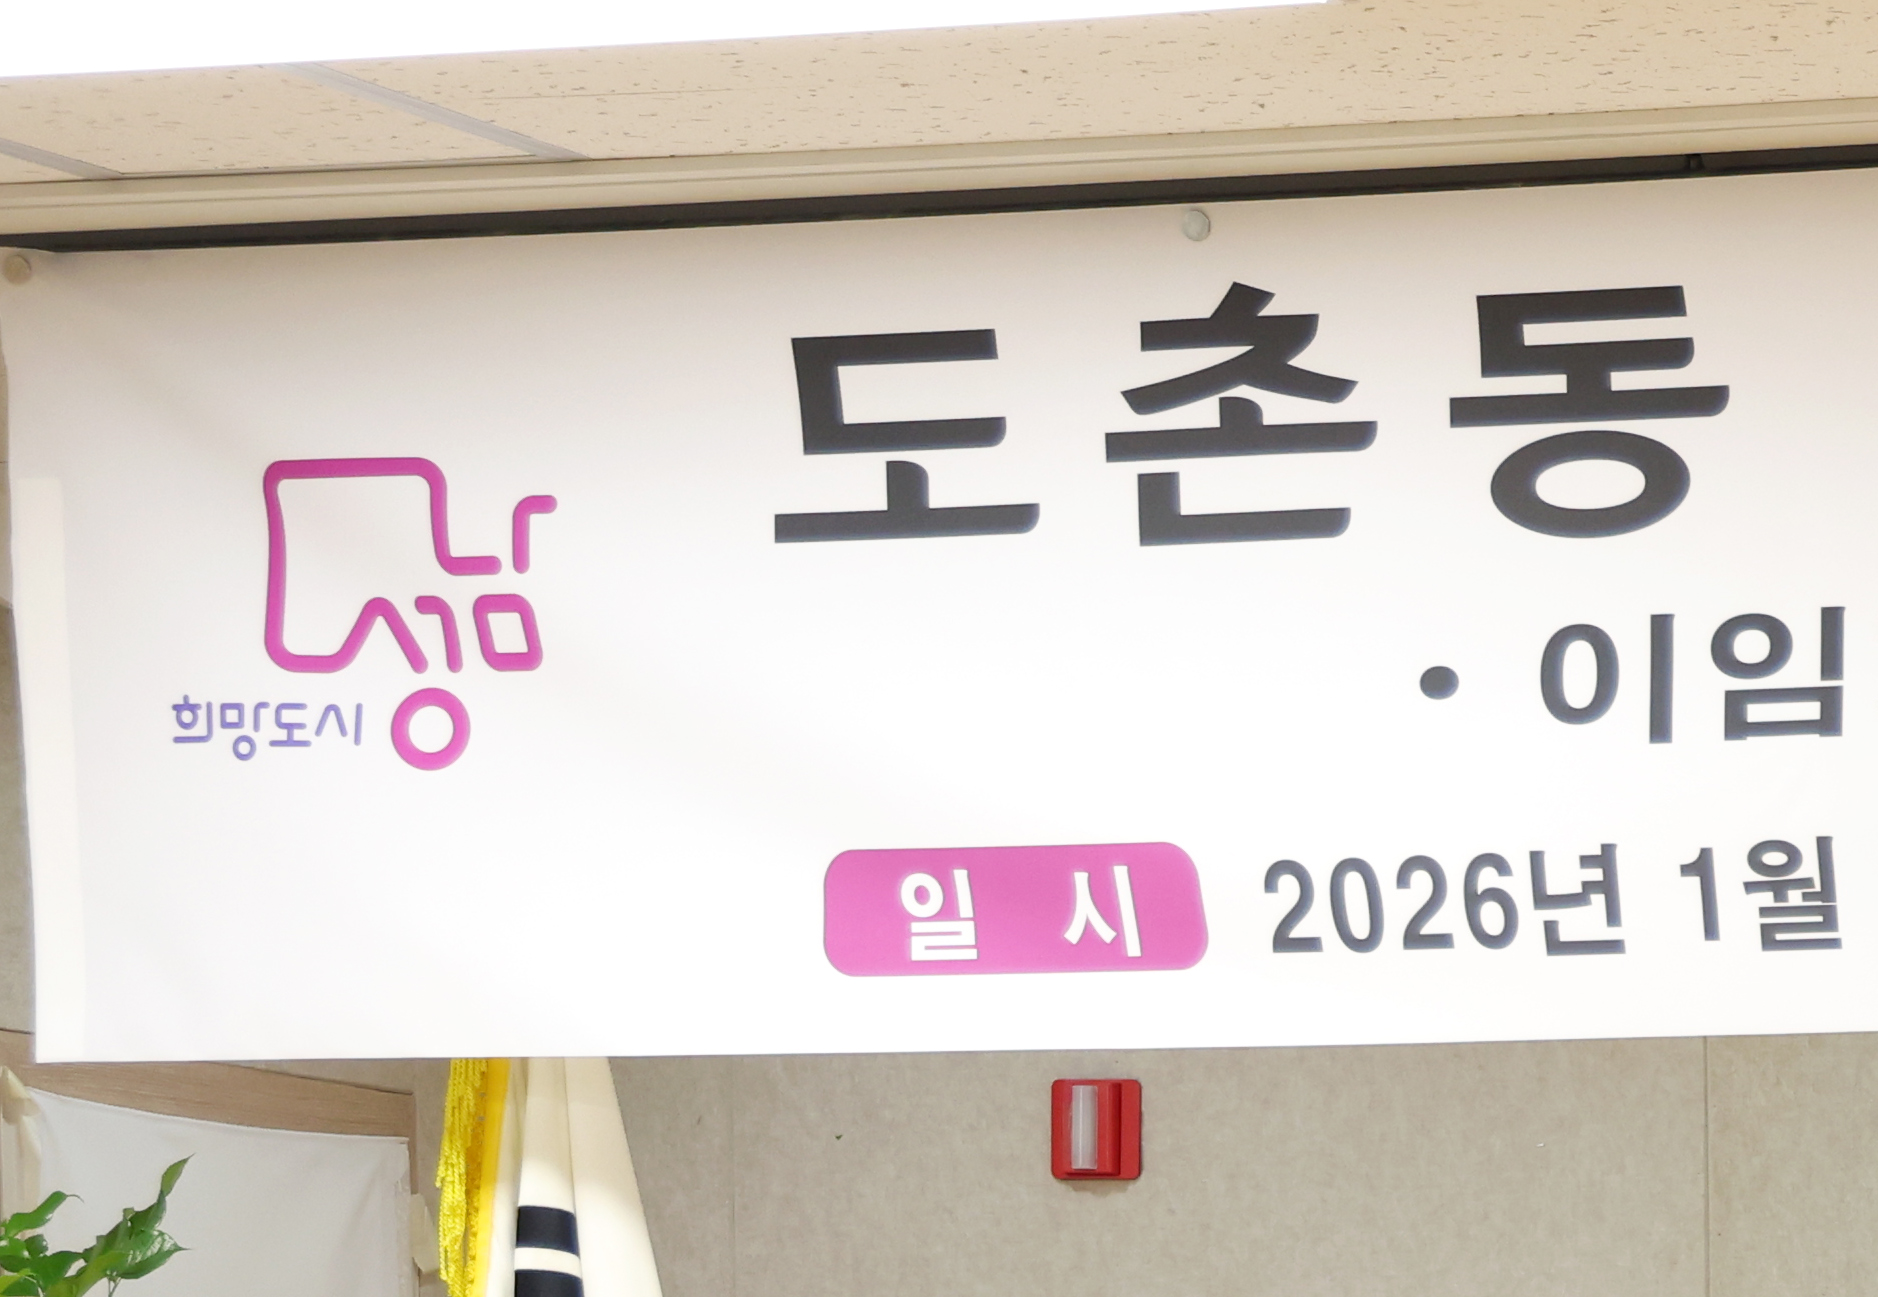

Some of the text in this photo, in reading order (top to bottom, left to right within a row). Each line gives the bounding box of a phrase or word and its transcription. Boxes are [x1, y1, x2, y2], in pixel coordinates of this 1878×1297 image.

[773, 279, 1731, 547] 도촌동
[171, 694, 364, 761] 희망도시
[1263, 842, 1625, 956] 2026년
[1679, 834, 1842, 952] 1월
